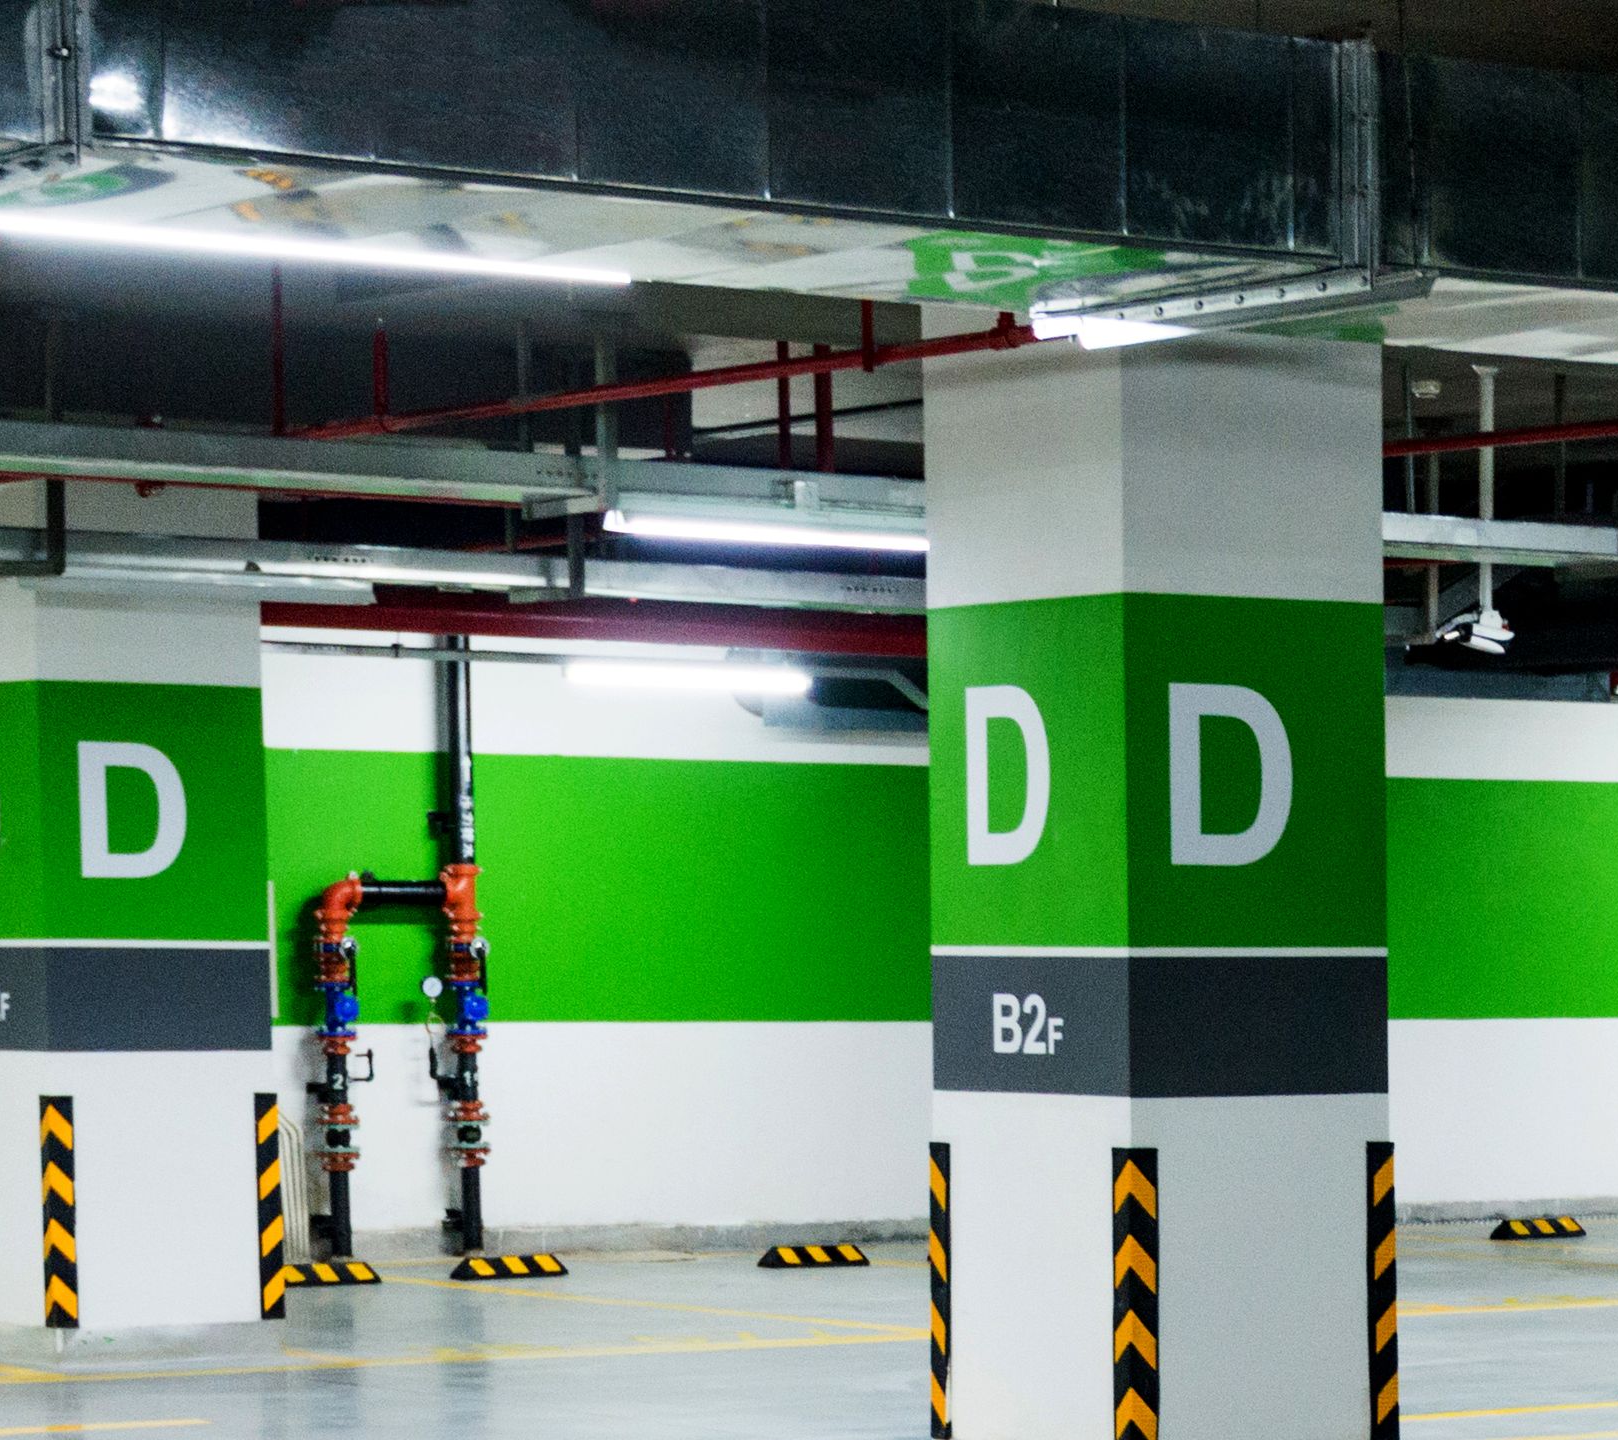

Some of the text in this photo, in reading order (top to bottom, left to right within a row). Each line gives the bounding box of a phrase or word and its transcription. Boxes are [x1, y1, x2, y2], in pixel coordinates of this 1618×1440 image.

[79, 742, 186, 877] D
[966, 685, 1049, 865] D
[1169, 682, 1292, 865] D
[992, 992, 1064, 1056] B2F
